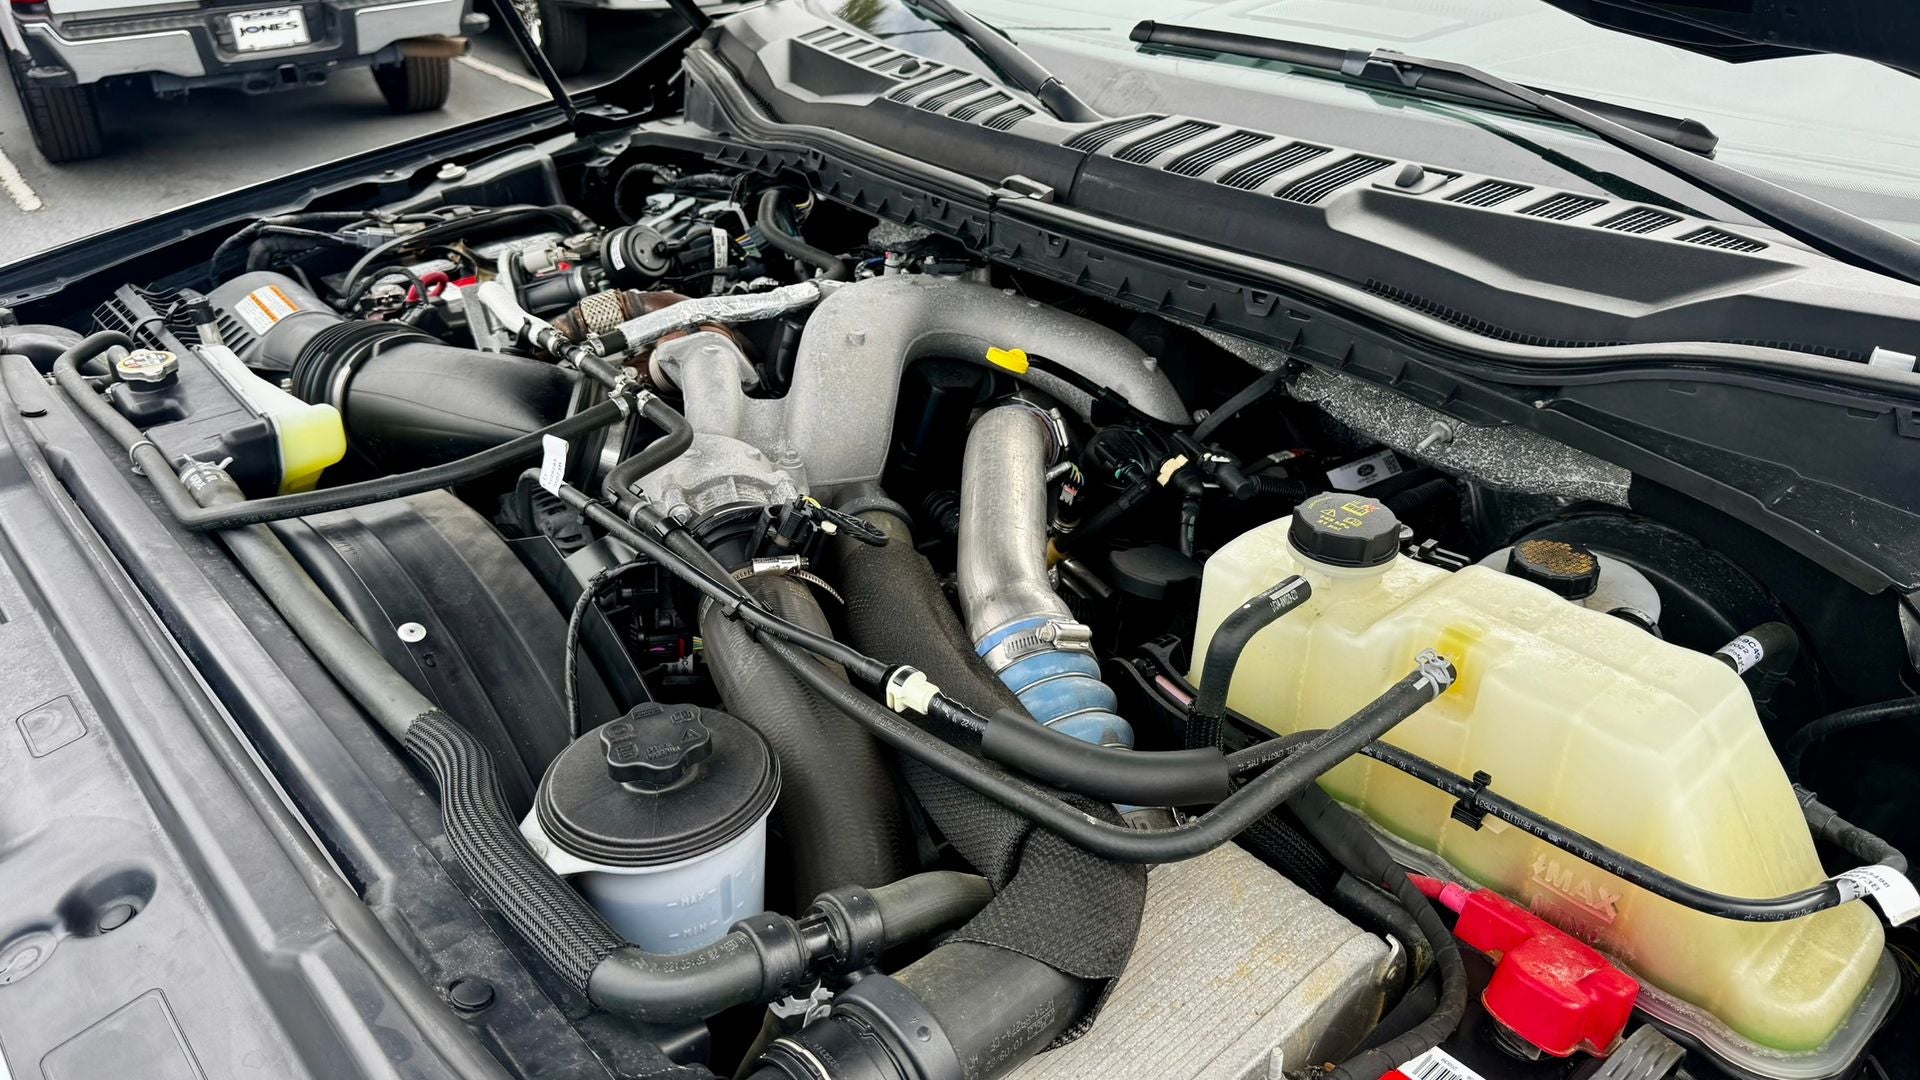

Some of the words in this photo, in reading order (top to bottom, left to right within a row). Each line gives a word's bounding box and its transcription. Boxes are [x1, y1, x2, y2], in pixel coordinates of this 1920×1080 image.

[239, 21, 299, 37] JONES
[1545, 858, 1622, 919] MAX
[680, 890, 706, 908] MAX
[682, 921, 708, 938] MIN
